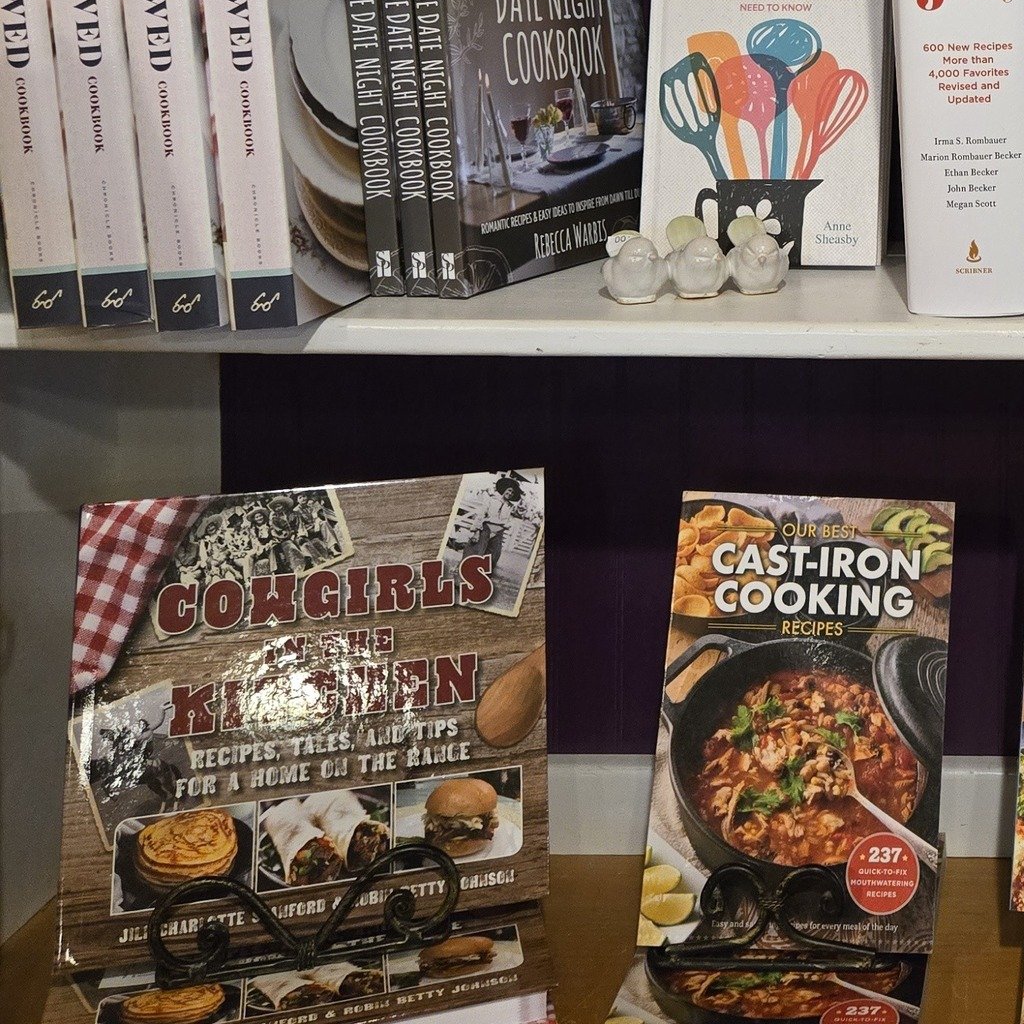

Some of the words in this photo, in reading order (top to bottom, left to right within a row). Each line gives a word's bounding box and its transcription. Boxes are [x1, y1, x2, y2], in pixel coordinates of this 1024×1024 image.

[739, 4, 765, 13] NEED
[767, 4, 780, 13] TO
[781, 4, 813, 13] KNOW
[350, 11, 379, 51] DATE
[502, 24, 607, 86] COOKBOOK
[354, 57, 384, 107] NIGHT
[239, 80, 255, 158] COOKBOOK
[359, 115, 392, 201] COOKBOOK
[480, 217, 510, 235] ROMANTIC
[510, 213, 533, 229] RECIPES
[533, 227, 572, 260] REBECCA
[572, 218, 609, 249] WARBIS
[823, 220, 852, 231] Anne
[814, 233, 860, 248] Sheasby
[782, 522, 817, 538] OUR
[822, 524, 858, 539] BEST
[711, 542, 922, 581] CAST-IRON
[154, 553, 496, 636] COWGIRLS
[714, 579, 914, 619] COOKING
[781, 620, 844, 637] RECIPES
[190, 739, 281, 771] RECIPES,
[293, 731, 355, 761] TALES,
[364, 724, 407, 748] AND
[413, 718, 460, 742] TIPS
[174, 773, 217, 800] FOR
[226, 771, 241, 791] A
[250, 762, 311, 789] HOME
[320, 758, 349, 779] ON
[357, 750, 398, 775] THE
[405, 740, 472, 768] RANGE
[868, 846, 903, 864] 237
[850, 879, 914, 888] MOUTHWATERING
[858, 867, 908, 876] QUICK-TO-FIX
[866, 890, 897, 899] RECIPES
[884, 924, 899, 933] day
